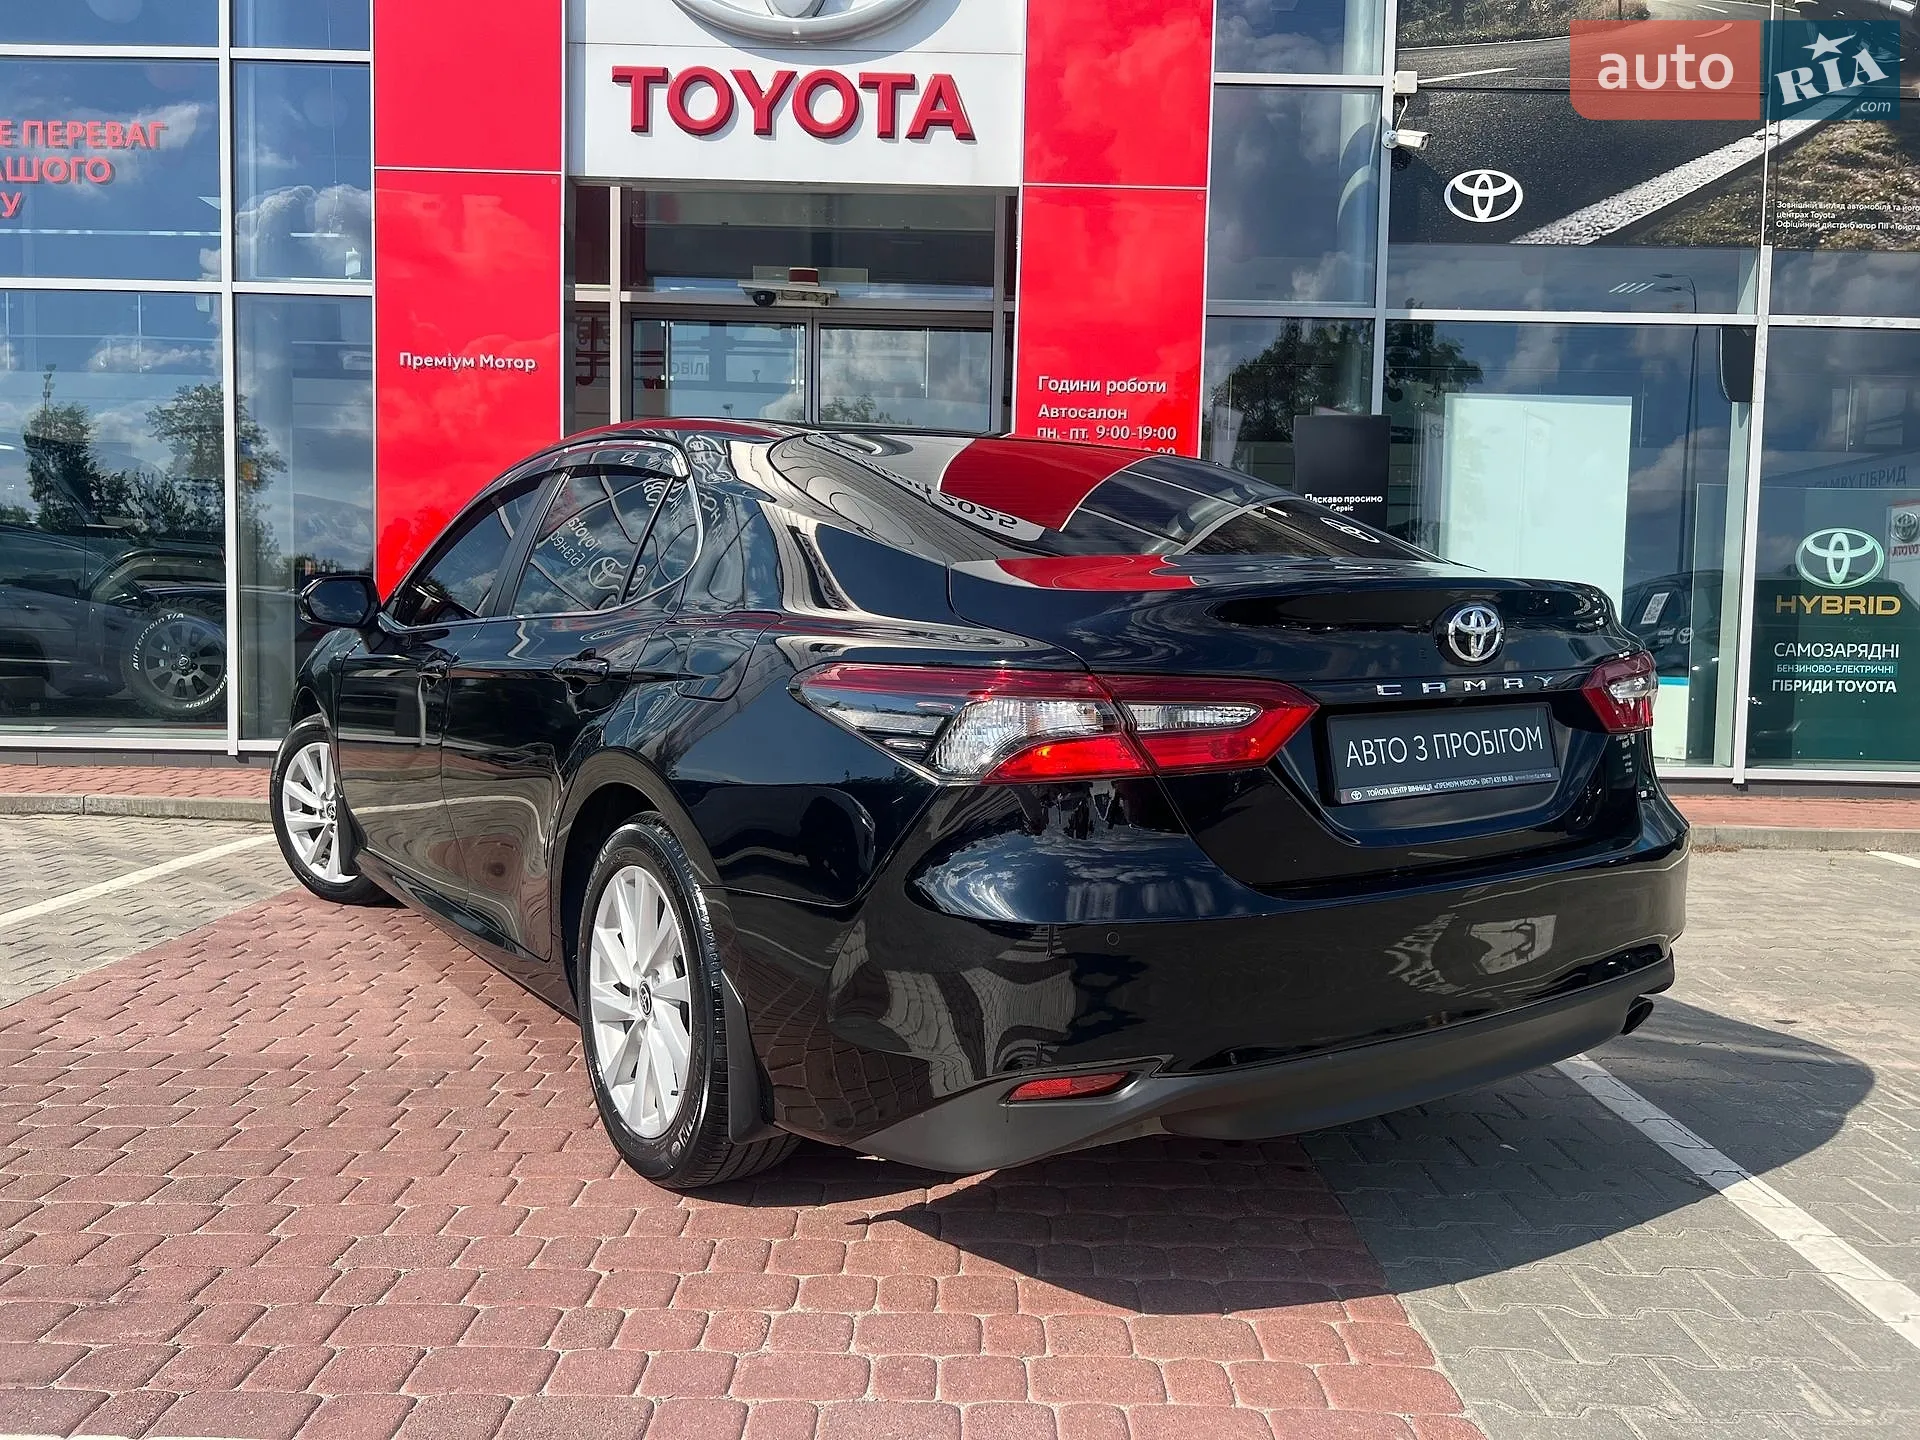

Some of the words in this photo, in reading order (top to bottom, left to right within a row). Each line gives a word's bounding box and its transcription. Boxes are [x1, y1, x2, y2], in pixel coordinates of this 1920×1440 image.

[612, 66, 977, 140] TOYOTA
[23, 121, 167, 148] ПЕРЕВАГ
[0, 157, 112, 183] ШОГО
[400, 352, 475, 371] Преміум
[479, 354, 536, 373] Мотор
[1038, 376, 1101, 394] Години
[1106, 377, 1167, 395] роботи
[1038, 404, 1127, 419] Автосалон
[1344, 495, 1383, 505] просимо
[1775, 595, 1901, 615] HYBRID
[1774, 643, 1900, 660] САМОЗАРЯДНІ
[1776, 664, 1894, 674] БЕНЗИНОВО-ЕЛЕКТРИЧНІ
[1376, 675, 1553, 696] CAMRY
[1772, 679, 1833, 693] ГІБРИДИ
[1835, 680, 1897, 693] TOYOTA
[1346, 736, 1408, 768] АВТО
[1433, 726, 1544, 760] ПРОБІГОМ
